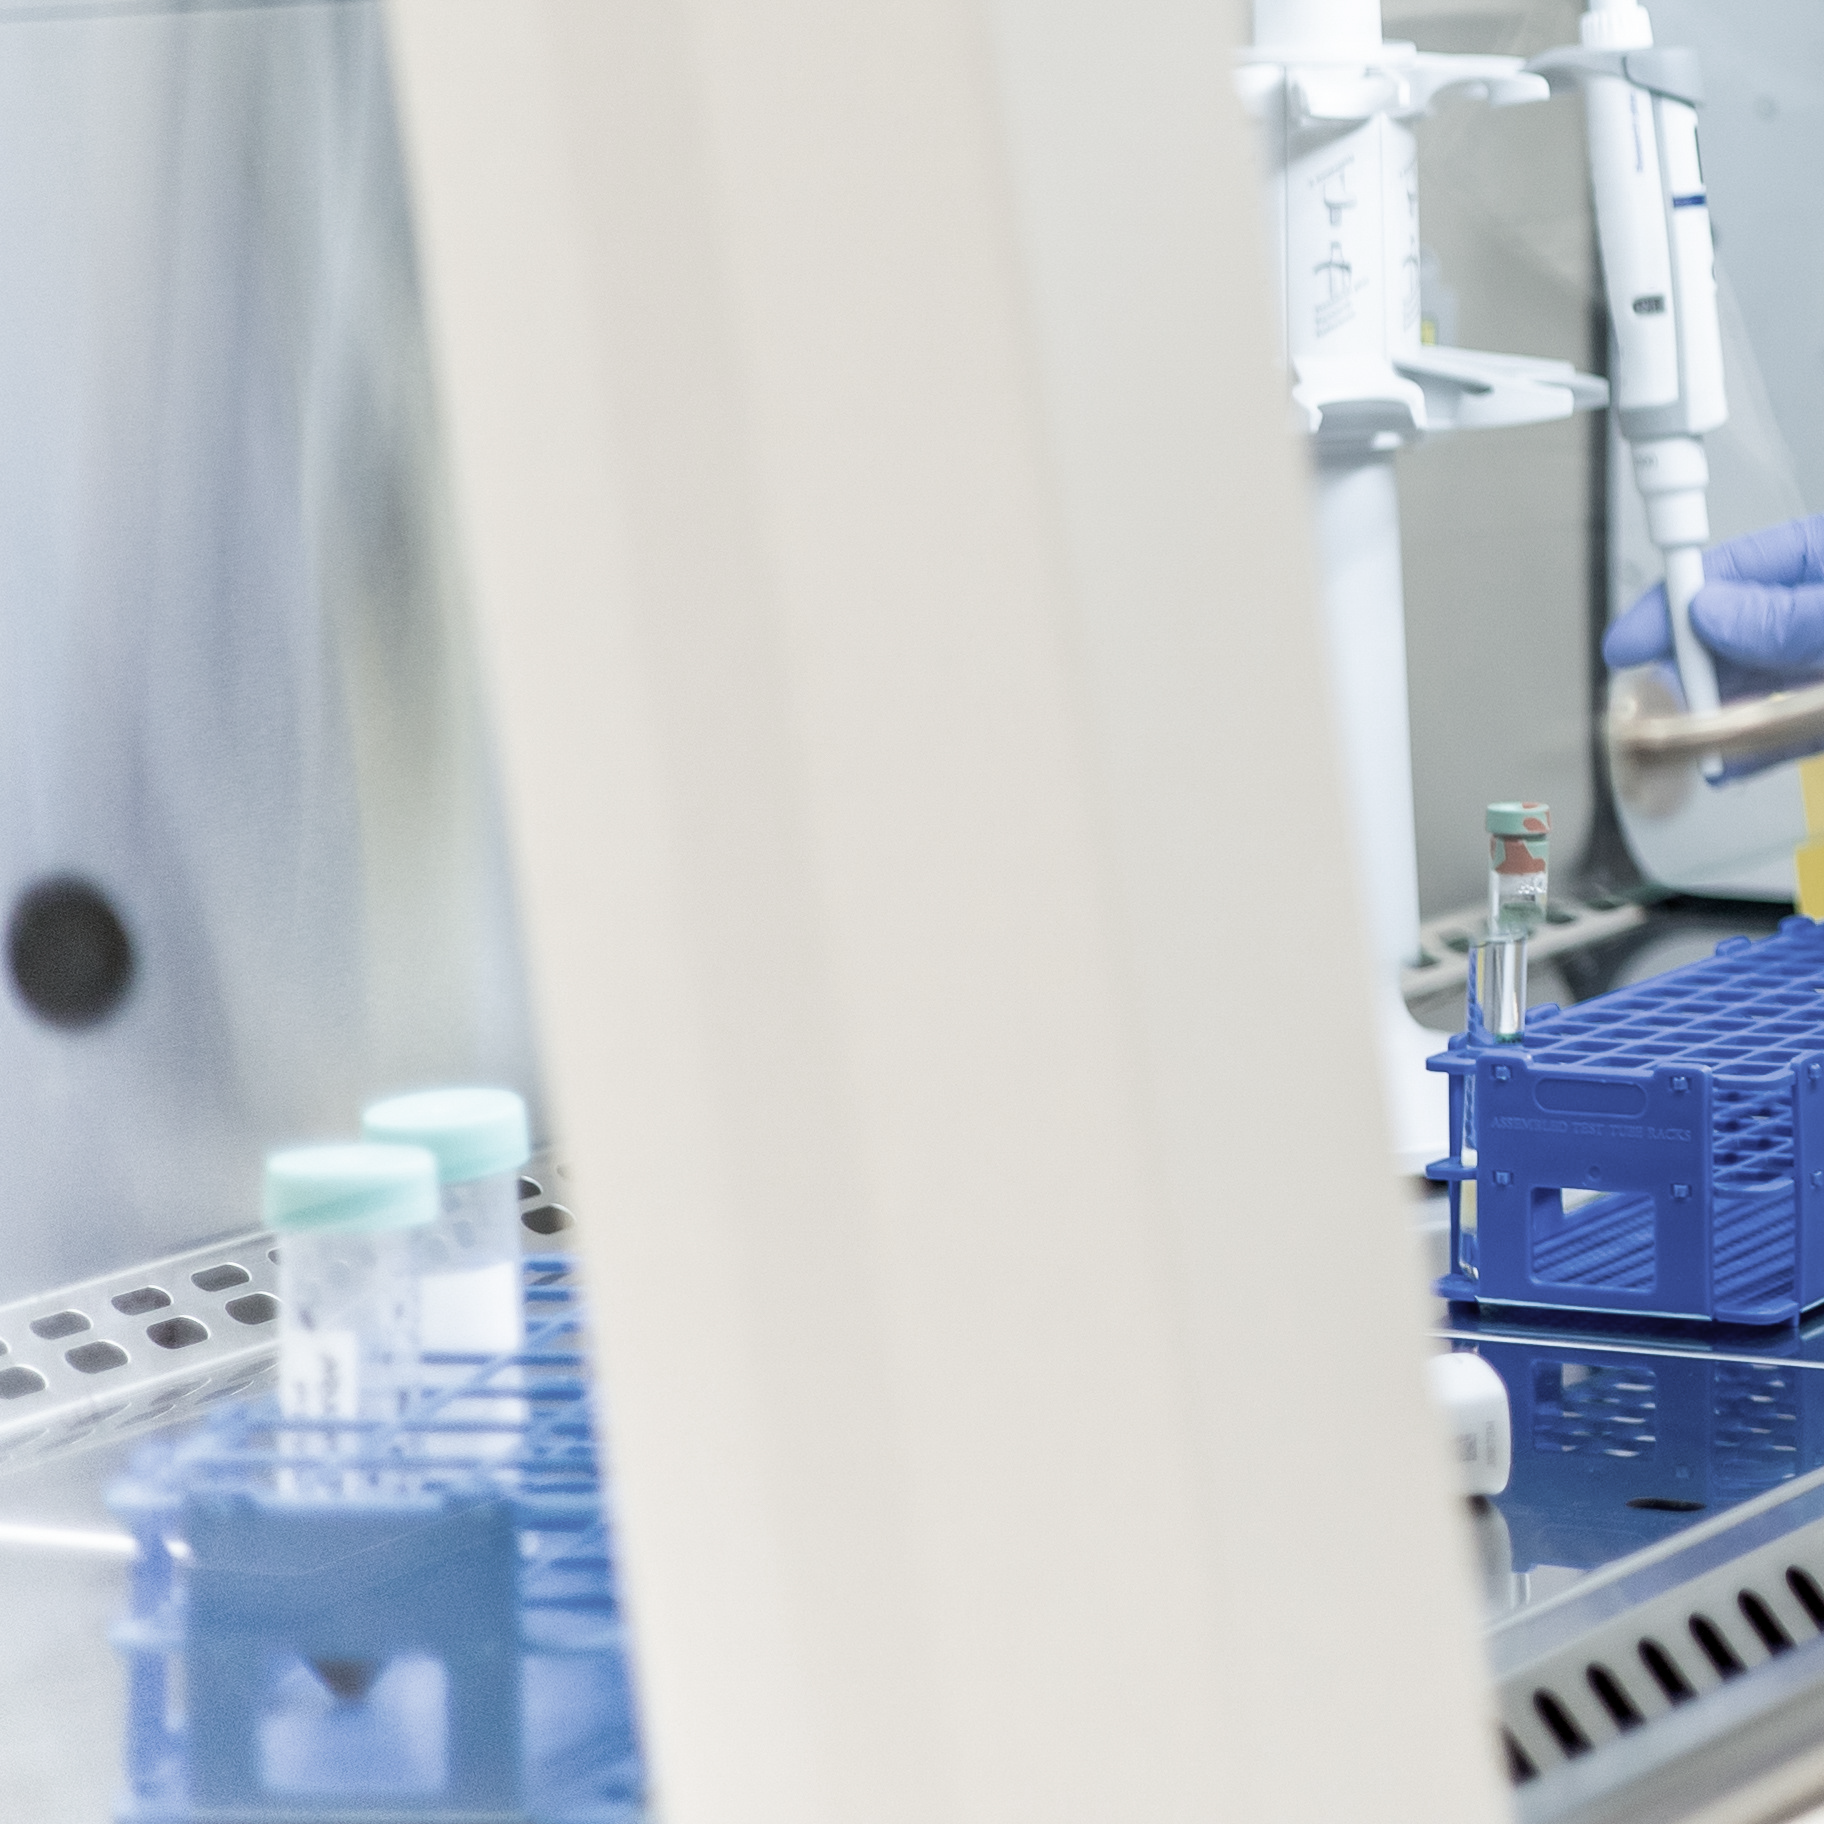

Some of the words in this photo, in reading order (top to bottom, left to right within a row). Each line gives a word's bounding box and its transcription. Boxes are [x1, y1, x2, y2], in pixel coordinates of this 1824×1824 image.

[1491, 1116, 1568, 1134] ASSEMBLED
[1571, 1121, 1605, 1136] TEST
[1608, 1124, 1643, 1139] TUBE
[1646, 1126, 1691, 1143] RACKS
